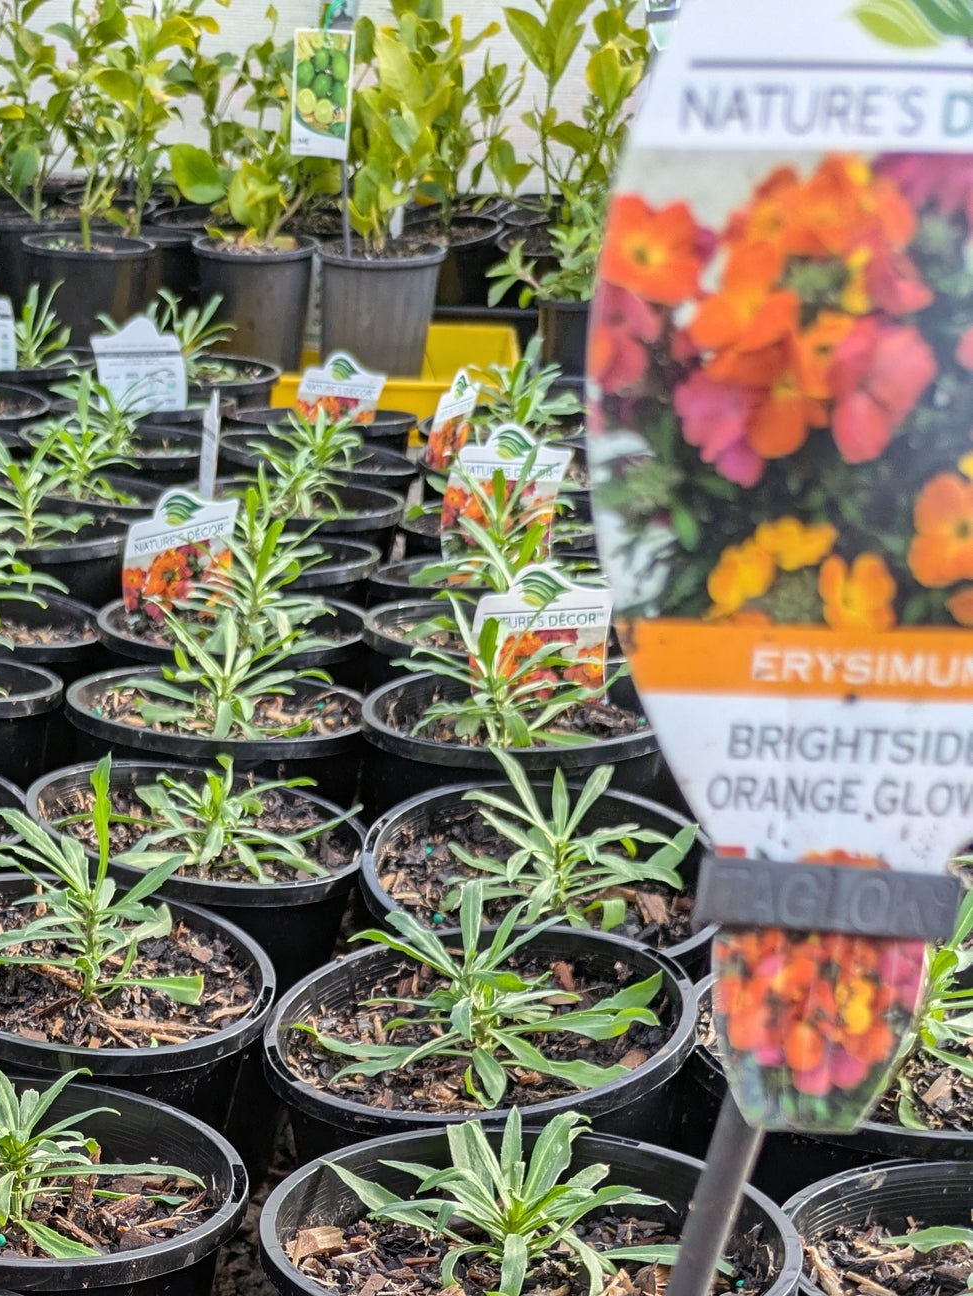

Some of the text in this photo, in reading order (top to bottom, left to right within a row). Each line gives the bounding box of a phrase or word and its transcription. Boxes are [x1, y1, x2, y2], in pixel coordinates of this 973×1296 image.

[677, 83, 928, 137] NATURE'S
[493, 614, 545, 629] TURES
[706, 775, 862, 815] ORANGE
